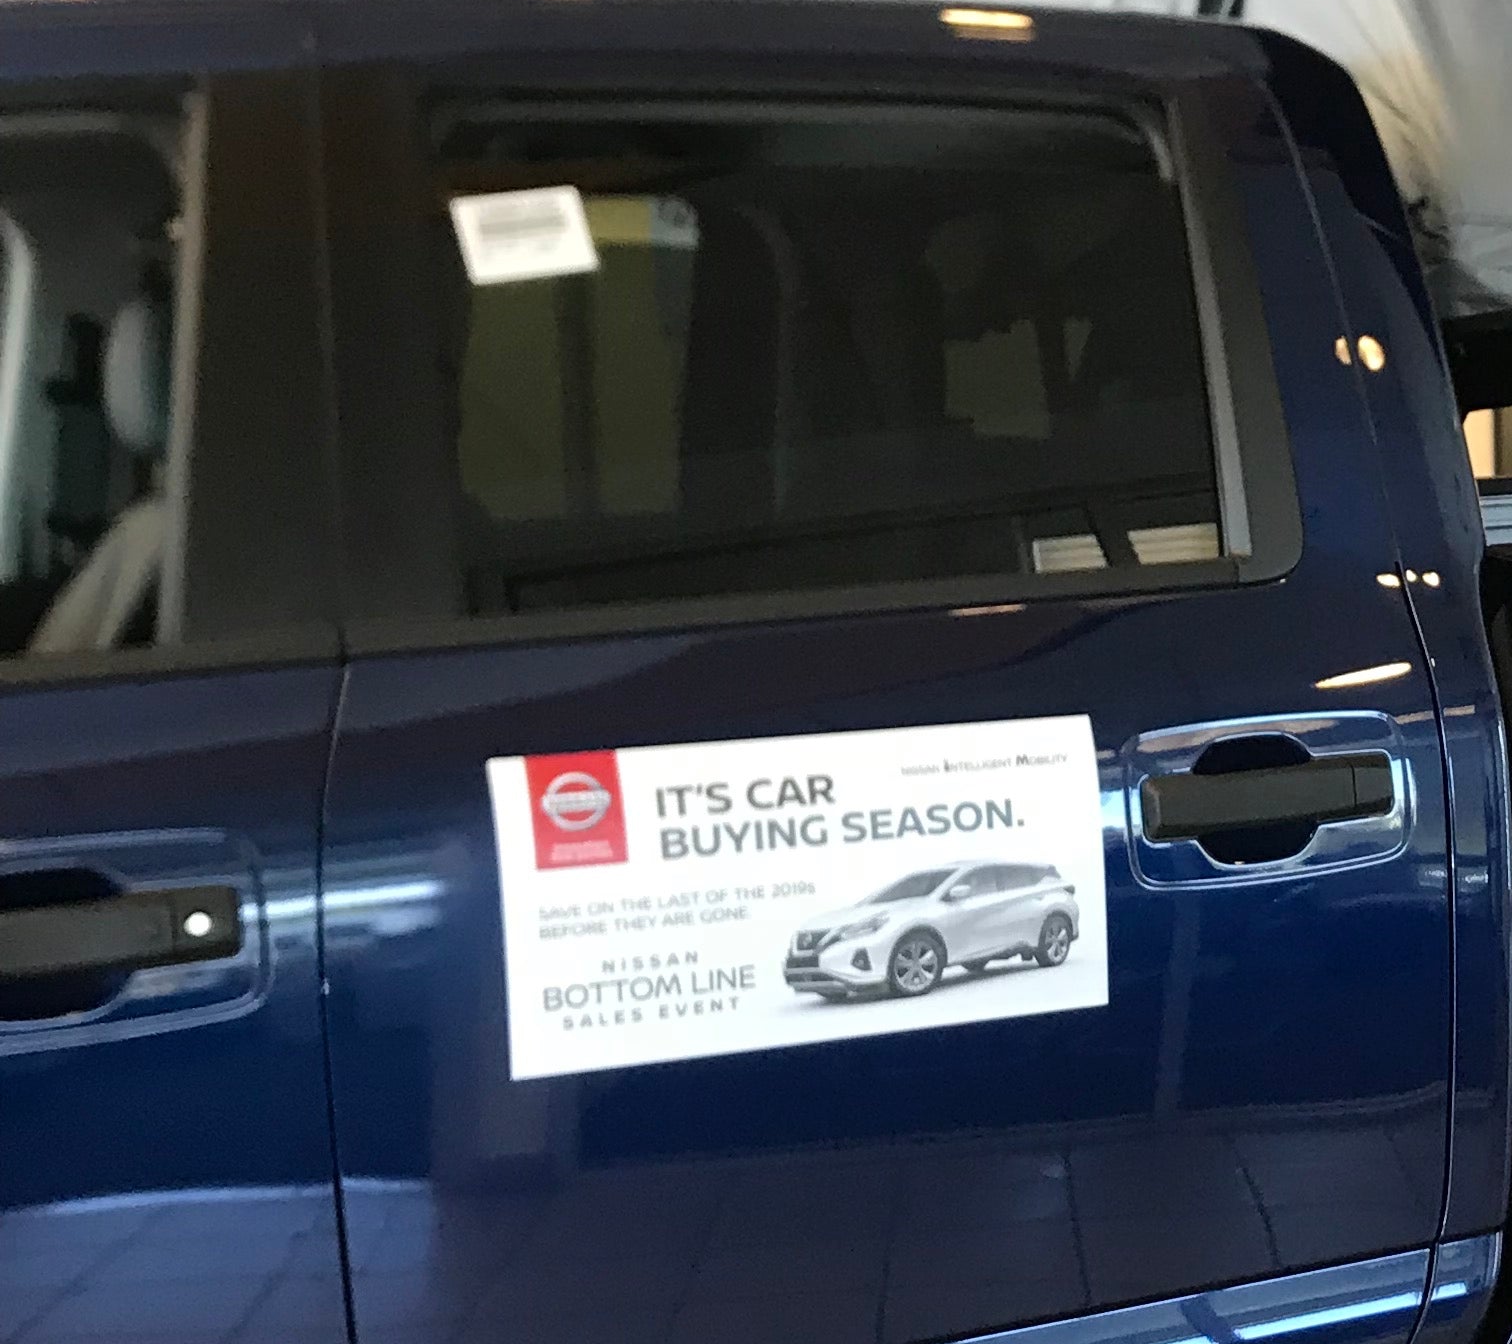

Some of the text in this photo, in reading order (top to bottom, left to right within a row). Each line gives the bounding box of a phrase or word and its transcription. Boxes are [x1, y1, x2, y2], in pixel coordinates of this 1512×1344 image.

[655, 774, 836, 818] IT'S CAR
[659, 814, 828, 860] BUYING
[841, 798, 1025, 844] SEASON.
[538, 903, 582, 922] SAVE
[587, 900, 615, 916] ON
[620, 896, 652, 912] THE
[656, 891, 700, 909] LAST
[705, 888, 728, 904] OF
[735, 885, 765, 901] THE
[538, 919, 608, 941] BEFORE
[614, 914, 657, 932] THEY
[661, 909, 694, 927] ARE
[602, 950, 699, 974] NISSAN
[542, 963, 757, 1013] BOTTOM LINE
[562, 995, 740, 1031] SALES EVENT
